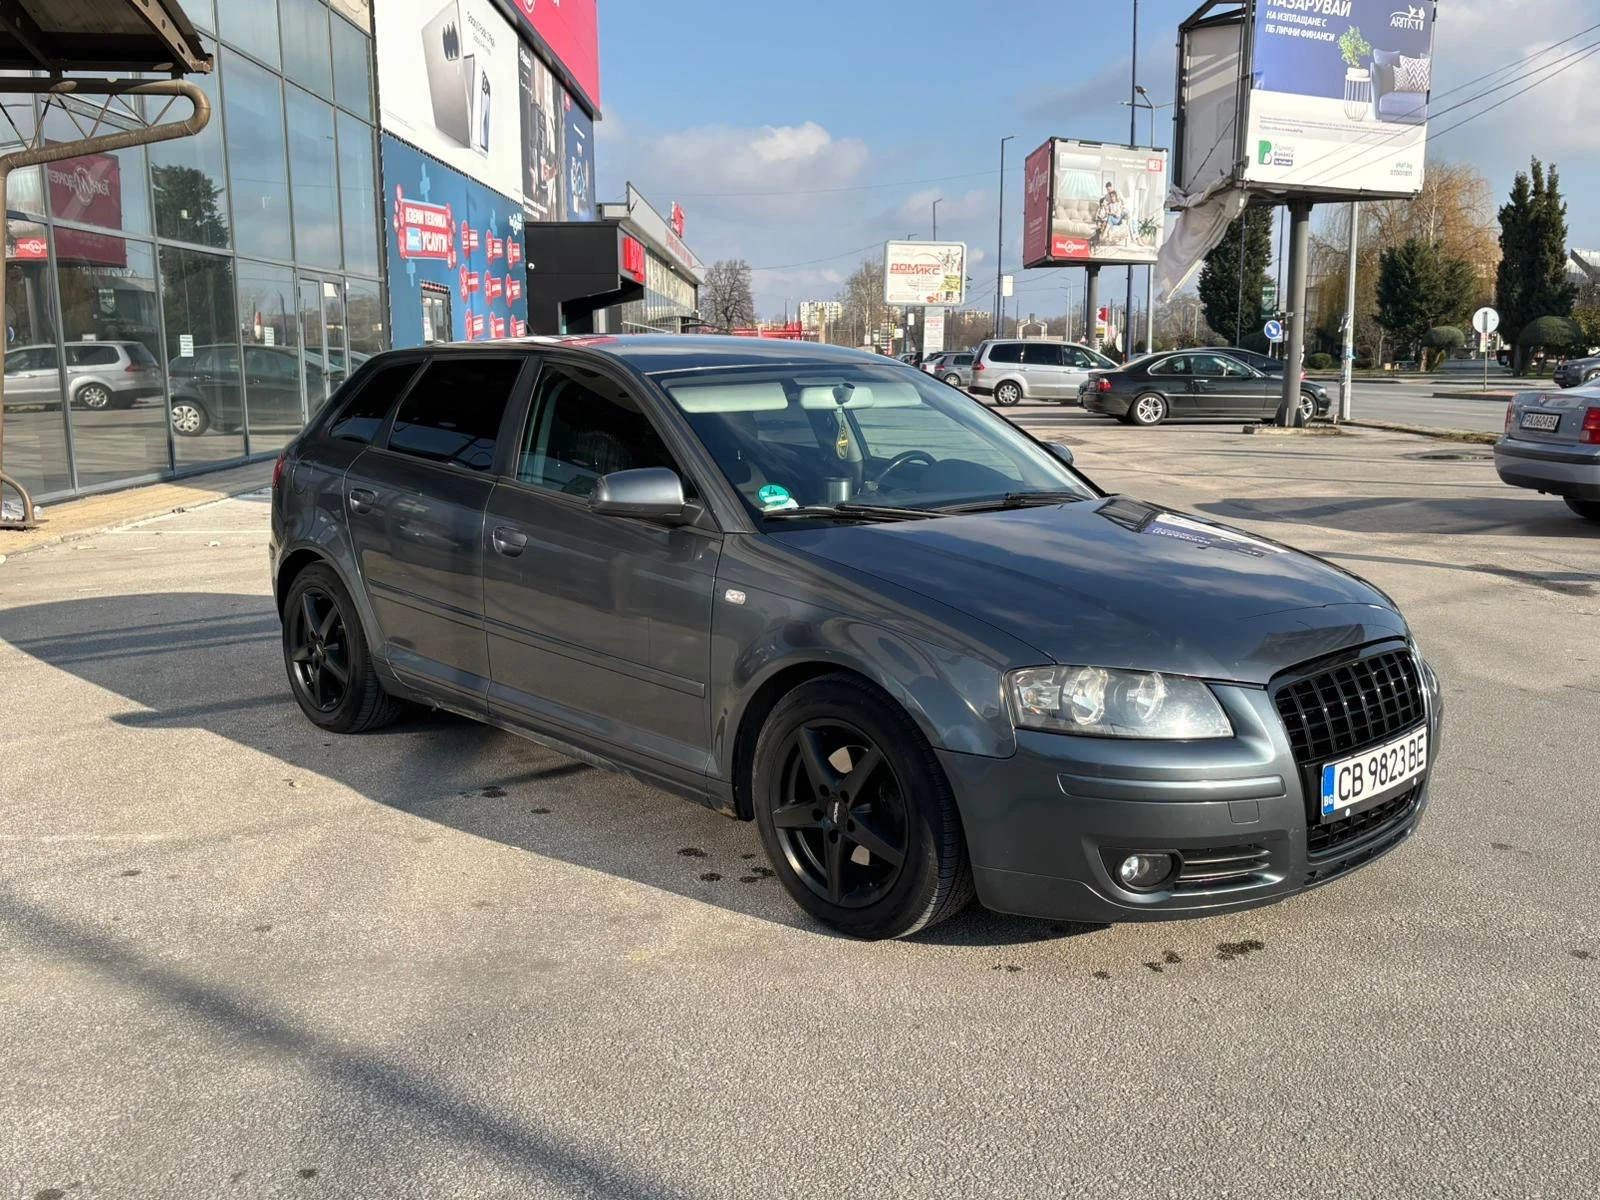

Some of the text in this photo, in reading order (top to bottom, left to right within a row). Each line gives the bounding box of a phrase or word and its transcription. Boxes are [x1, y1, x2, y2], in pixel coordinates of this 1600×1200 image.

[1266, 10, 1277, 21] НА
[1277, 12, 1322, 27] ИЗПЛАЩАНЕ
[1265, 24, 1336, 42] ПБ ЛИЧНИ ФИНАНСИ
[768, 486, 778, 496] 4
[1338, 734, 1425, 802] CB 9823 BE
[1323, 795, 1334, 807] BG
